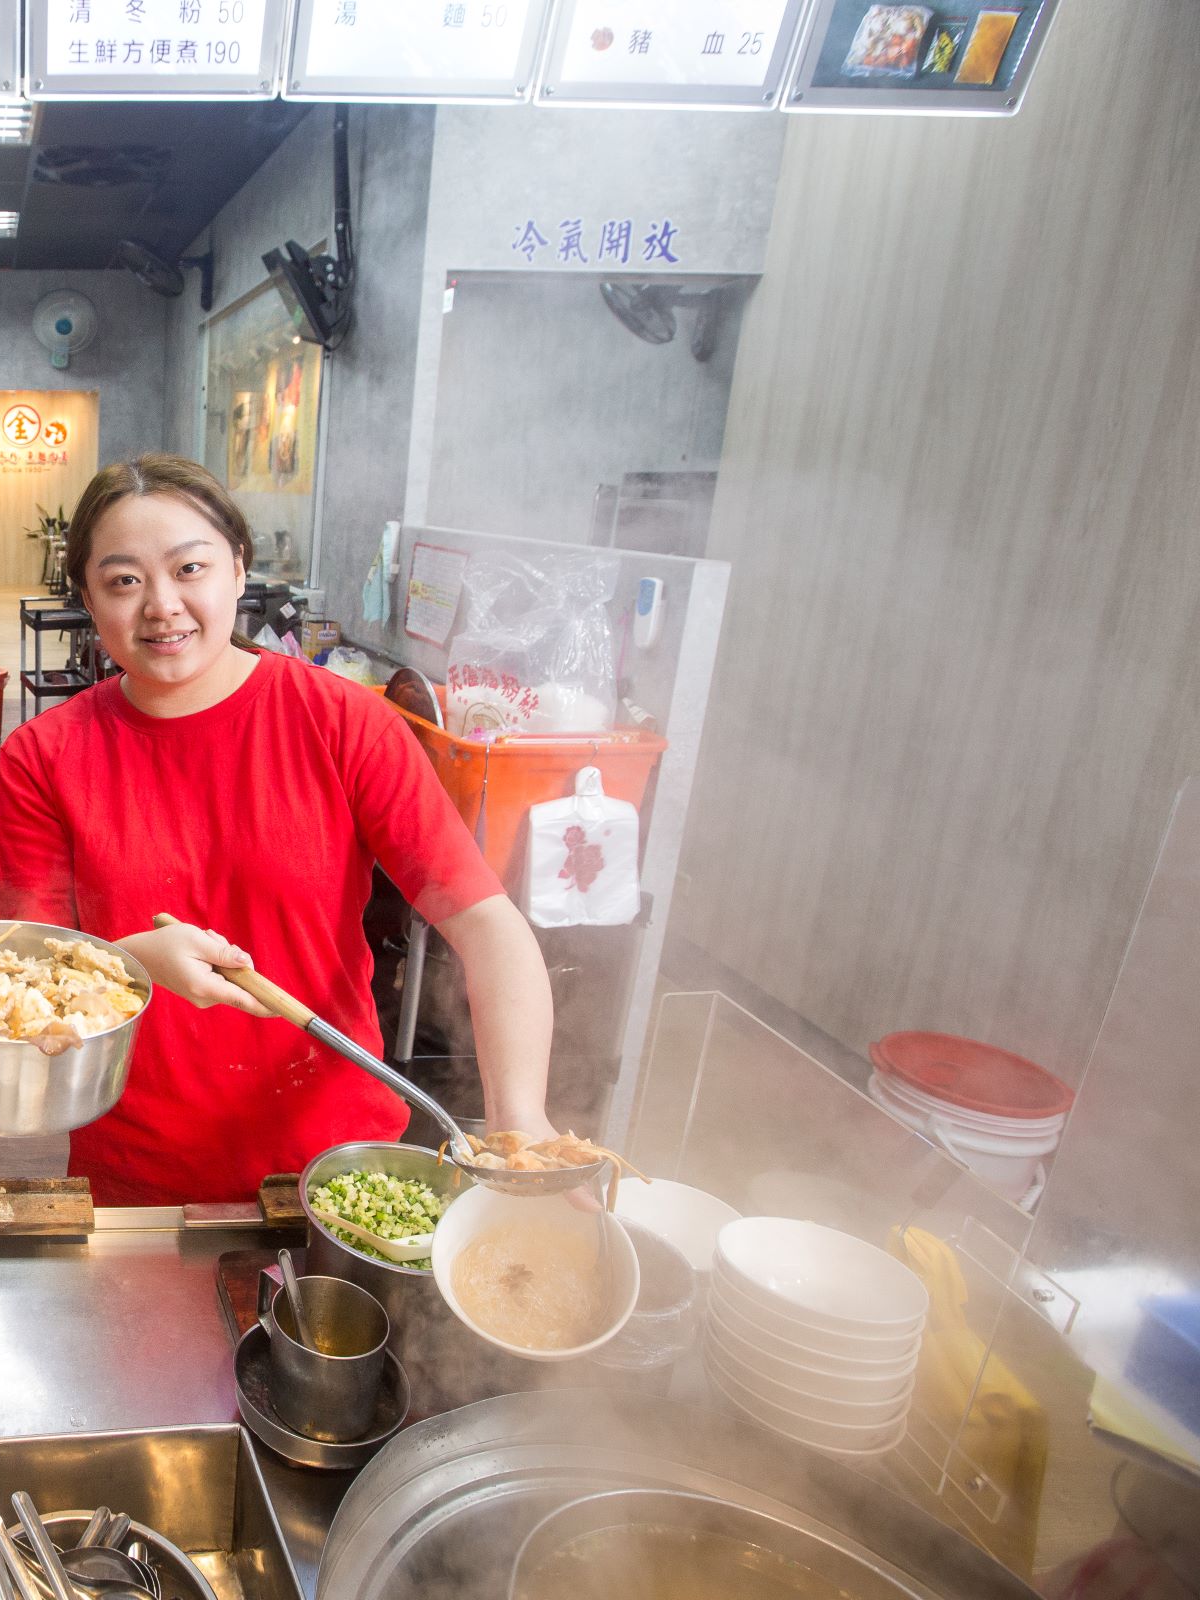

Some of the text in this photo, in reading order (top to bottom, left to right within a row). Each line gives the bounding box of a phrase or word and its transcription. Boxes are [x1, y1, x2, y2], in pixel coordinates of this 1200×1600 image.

[218, 0, 244, 24] 50
[480, 3, 509, 28] 50
[68, 39, 240, 64] 生鮮方便煮 190
[737, 32, 765, 55] 25
[511, 218, 680, 264] 冷氣開放
